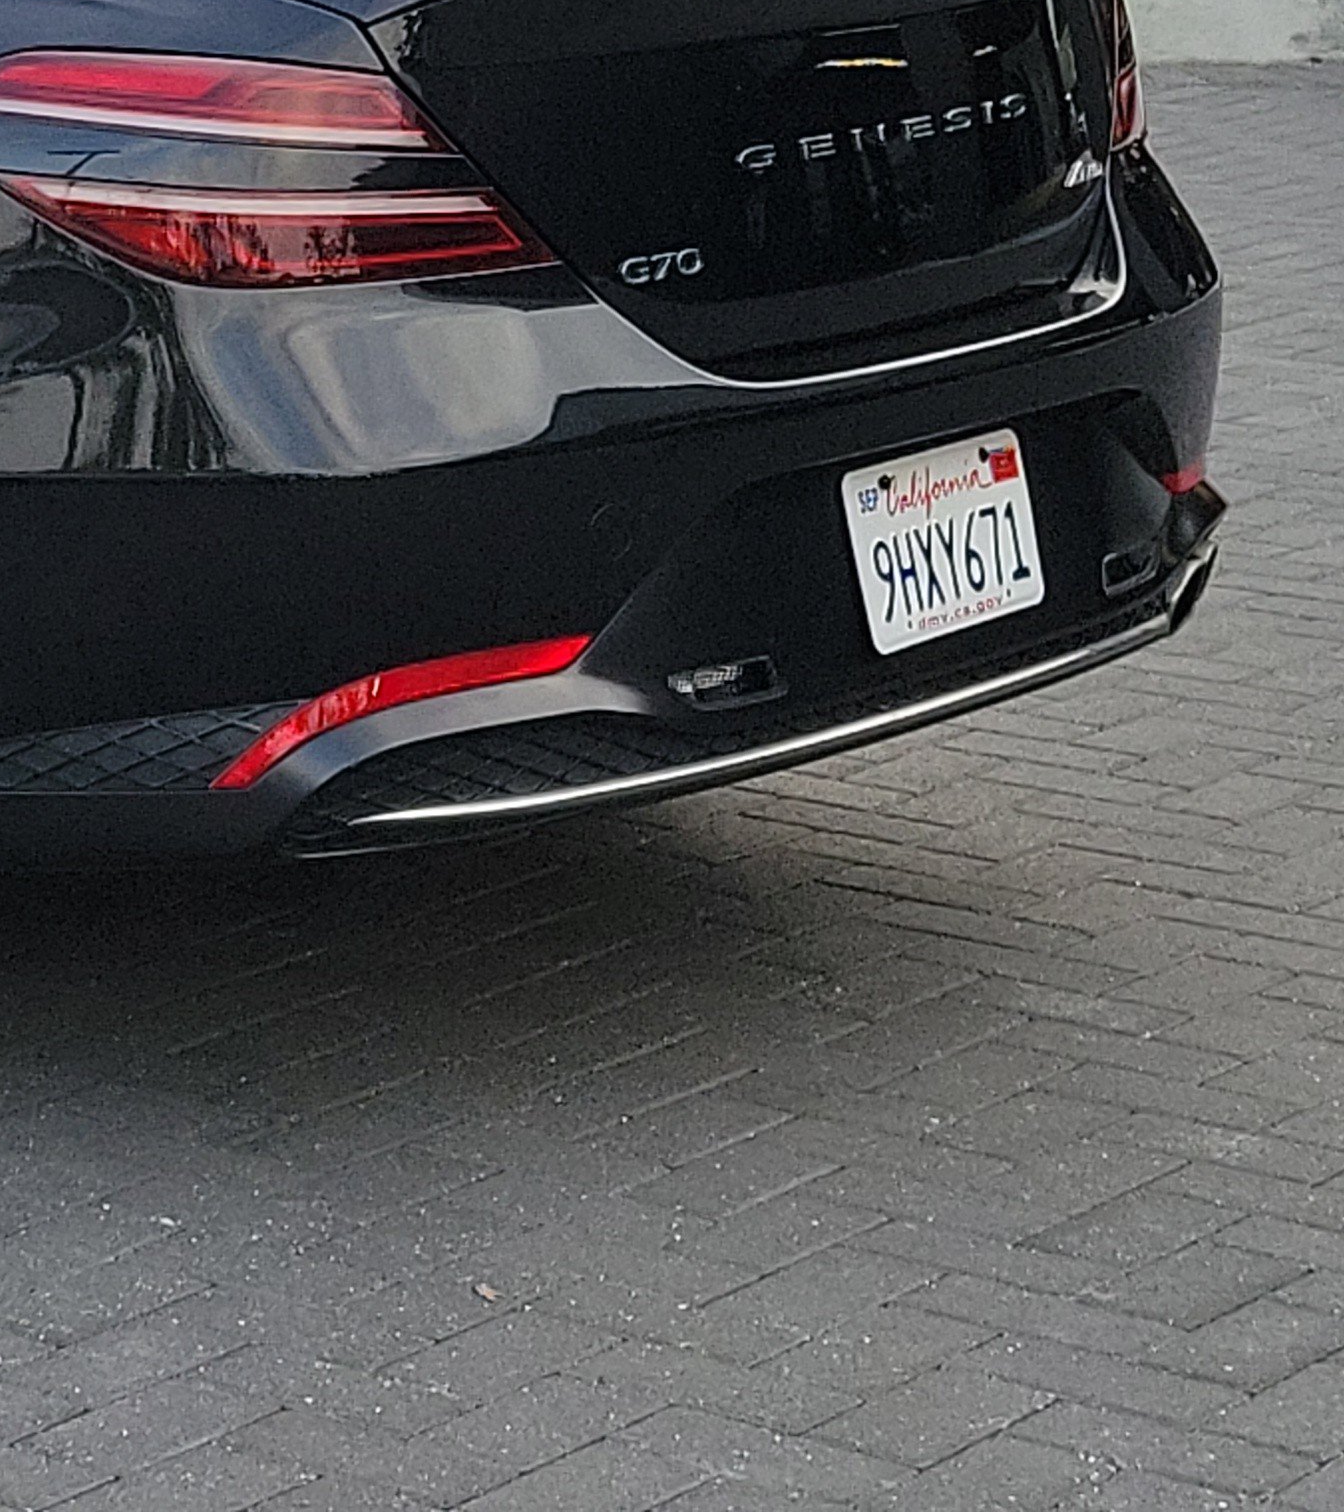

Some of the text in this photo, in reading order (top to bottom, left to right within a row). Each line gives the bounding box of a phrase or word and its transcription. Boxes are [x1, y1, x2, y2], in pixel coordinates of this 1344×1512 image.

[734, 92, 1028, 172] GENESIS
[618, 248, 704, 286] G70
[884, 459, 993, 520] California
[872, 500, 1032, 624] 9HXY671
[918, 595, 1004, 631] dmv.ca.gov
